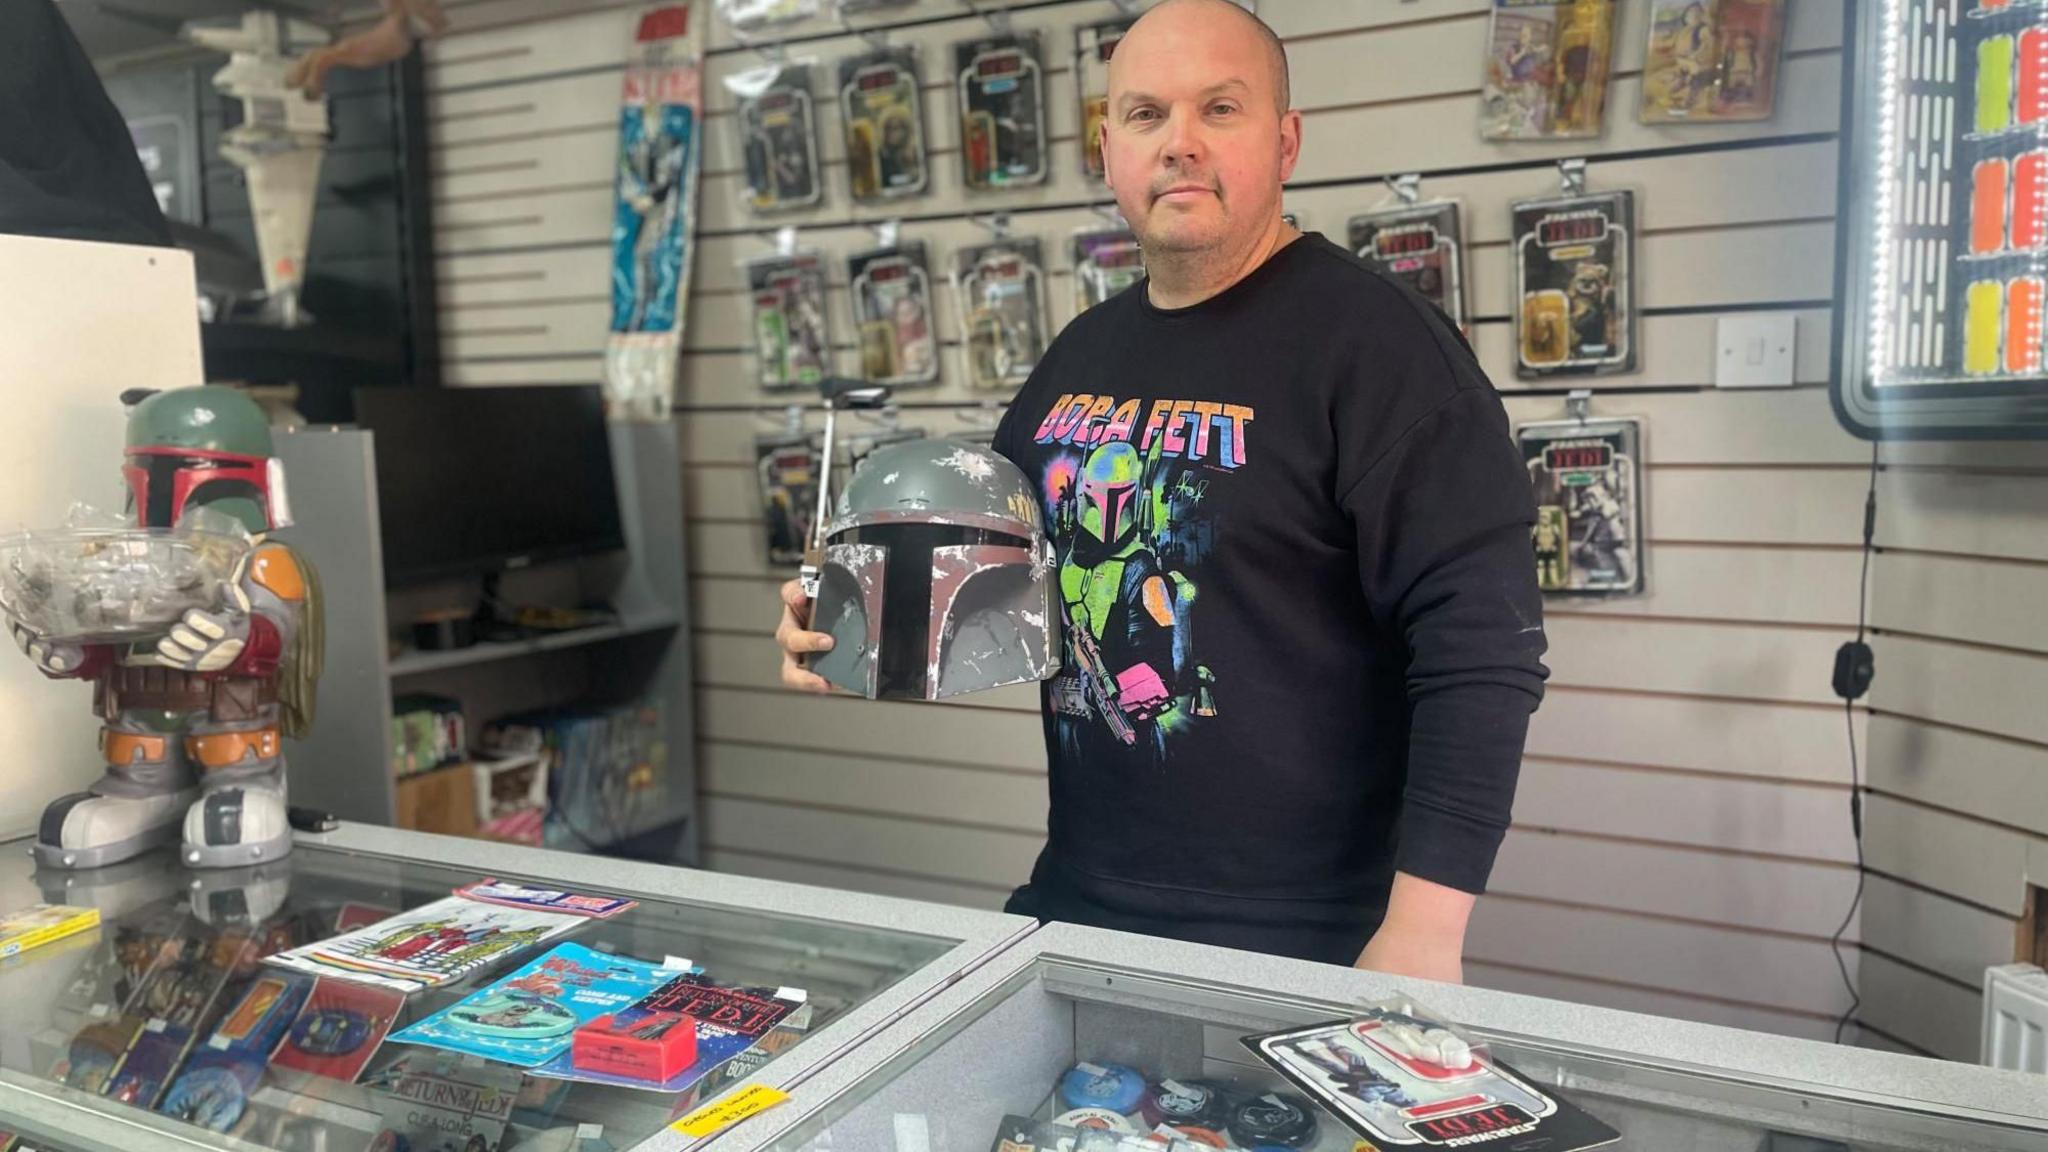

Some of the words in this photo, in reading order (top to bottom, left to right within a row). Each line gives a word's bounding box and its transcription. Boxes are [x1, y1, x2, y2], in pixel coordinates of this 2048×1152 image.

[1034, 394, 1141, 447] BOBA
[1140, 399, 1254, 468] FETT
[657, 994, 763, 1028] JEDI
[1425, 1108, 1512, 1138] JEDI
[1495, 1124, 1536, 1137] STAR
[1445, 1130, 1498, 1148] WARS
